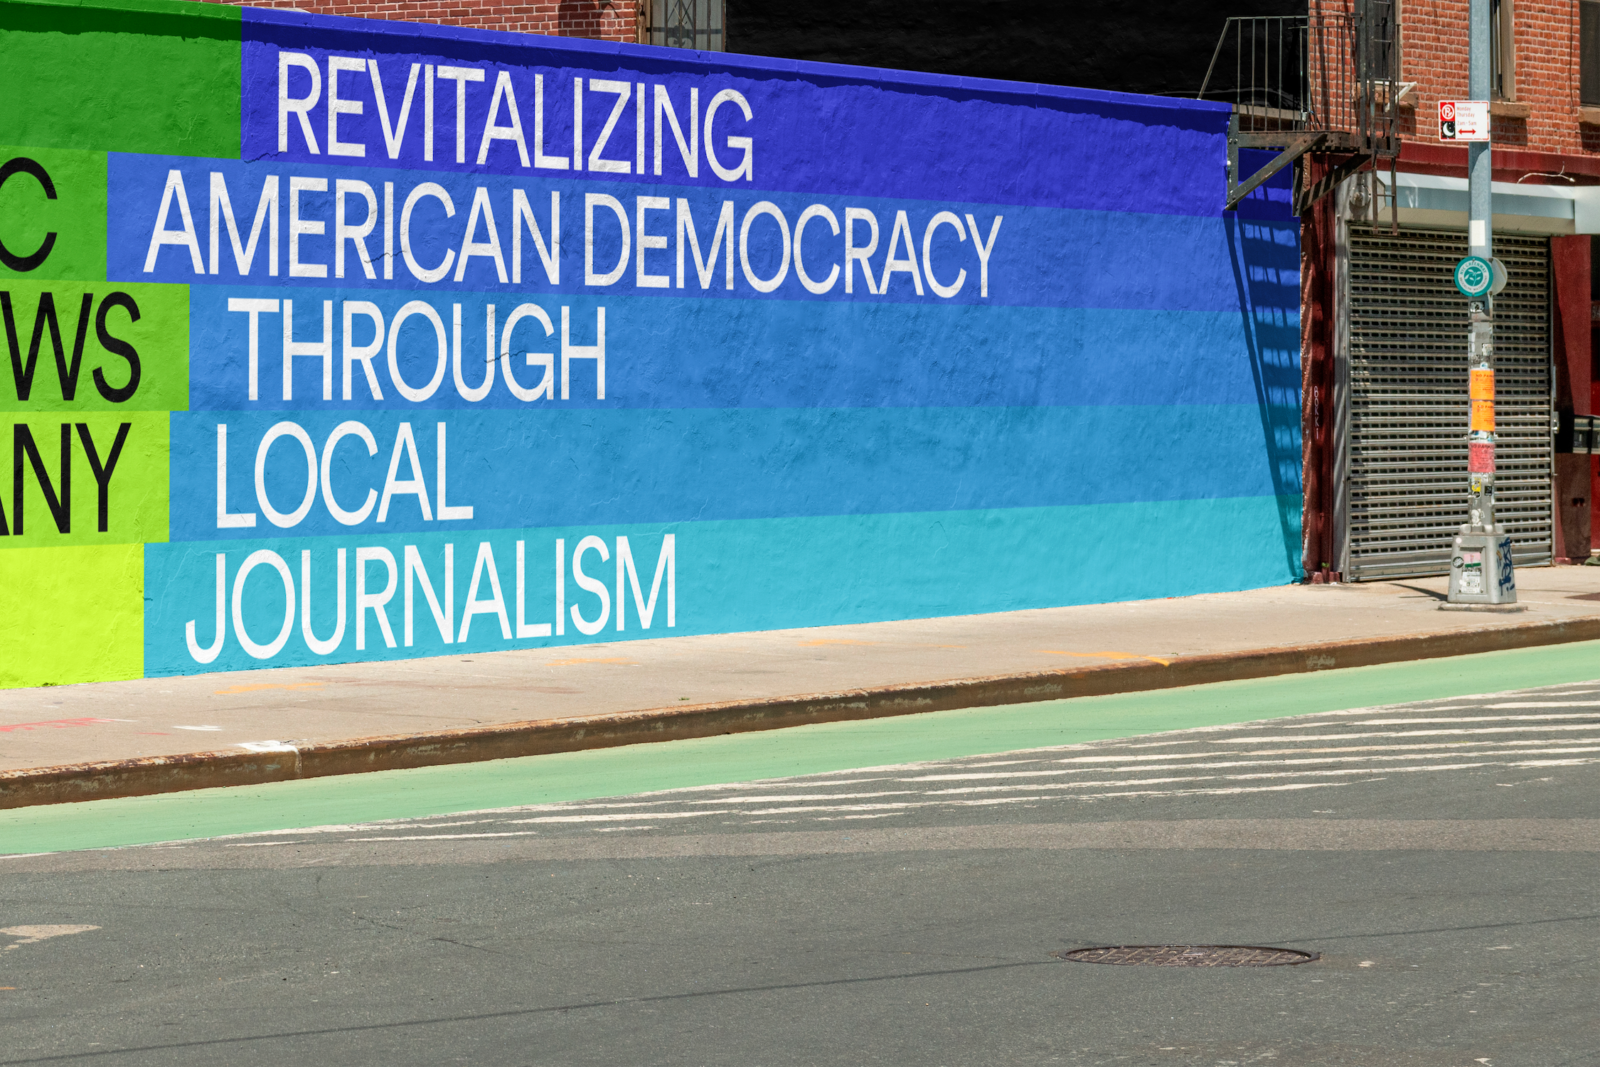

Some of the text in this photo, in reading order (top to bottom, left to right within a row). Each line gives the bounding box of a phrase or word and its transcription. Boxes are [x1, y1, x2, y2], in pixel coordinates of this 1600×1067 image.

[279, 52, 753, 183] REVITALIZING
[143, 170, 1004, 299] AMERICAN DEMOCRACY
[228, 298, 606, 402] THROUGH
[217, 420, 474, 529] LOCAL
[186, 534, 675, 665] JOURNALISM
